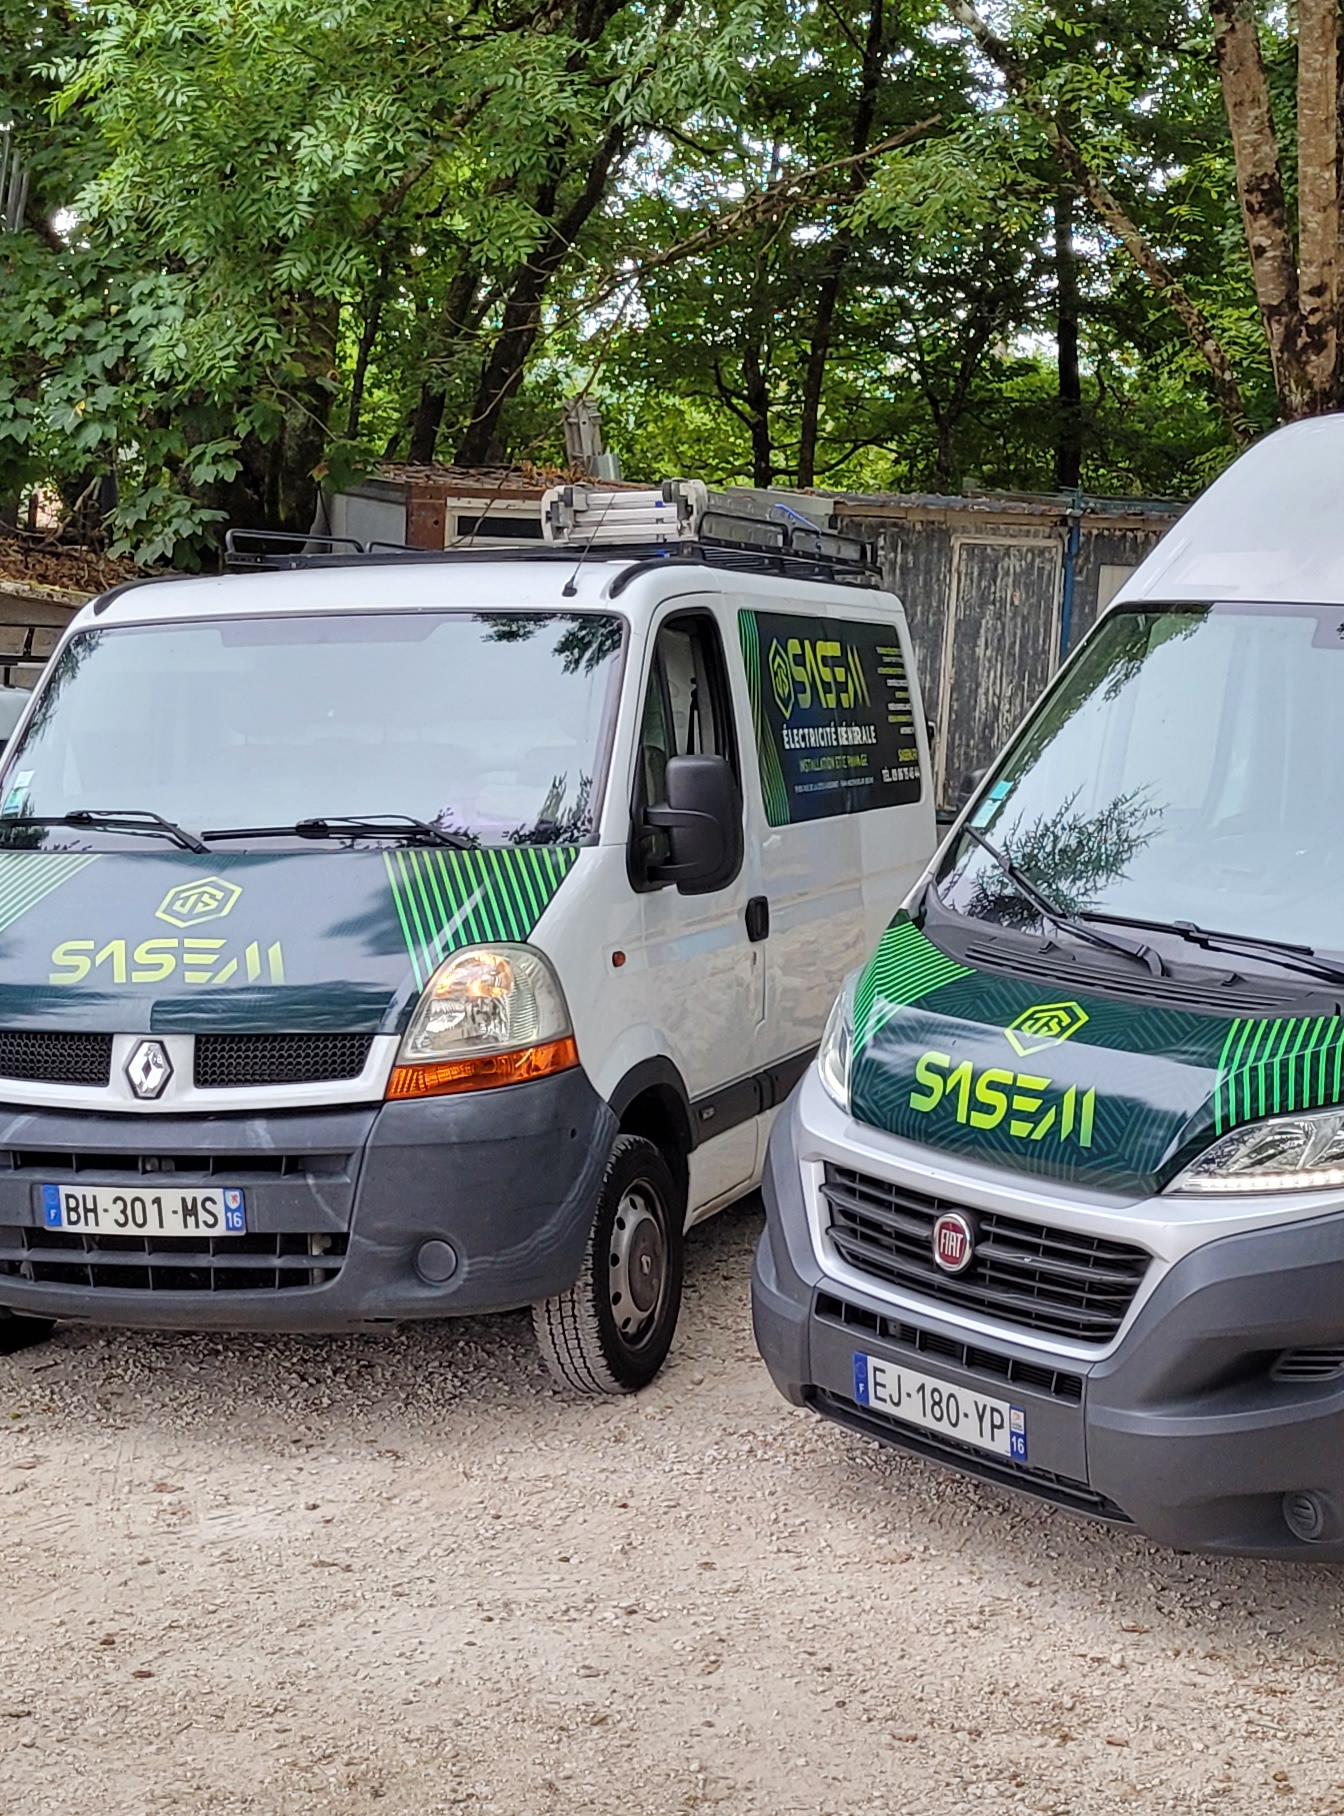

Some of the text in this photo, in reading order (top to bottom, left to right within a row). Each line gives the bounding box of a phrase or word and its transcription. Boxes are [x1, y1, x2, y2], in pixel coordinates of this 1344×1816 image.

[782, 722, 837, 750] ÉLECTRICITÉ
[49, 938, 286, 985] SASEM
[909, 1050, 1096, 1148] SASEM
[49, 1193, 243, 1230] F BH-301-MS 16
[940, 1228, 965, 1259] FIAT
[858, 1382, 865, 1395] F
[872, 1365, 1006, 1443] EJ-180-YP
[1011, 1435, 1025, 1455] 16
